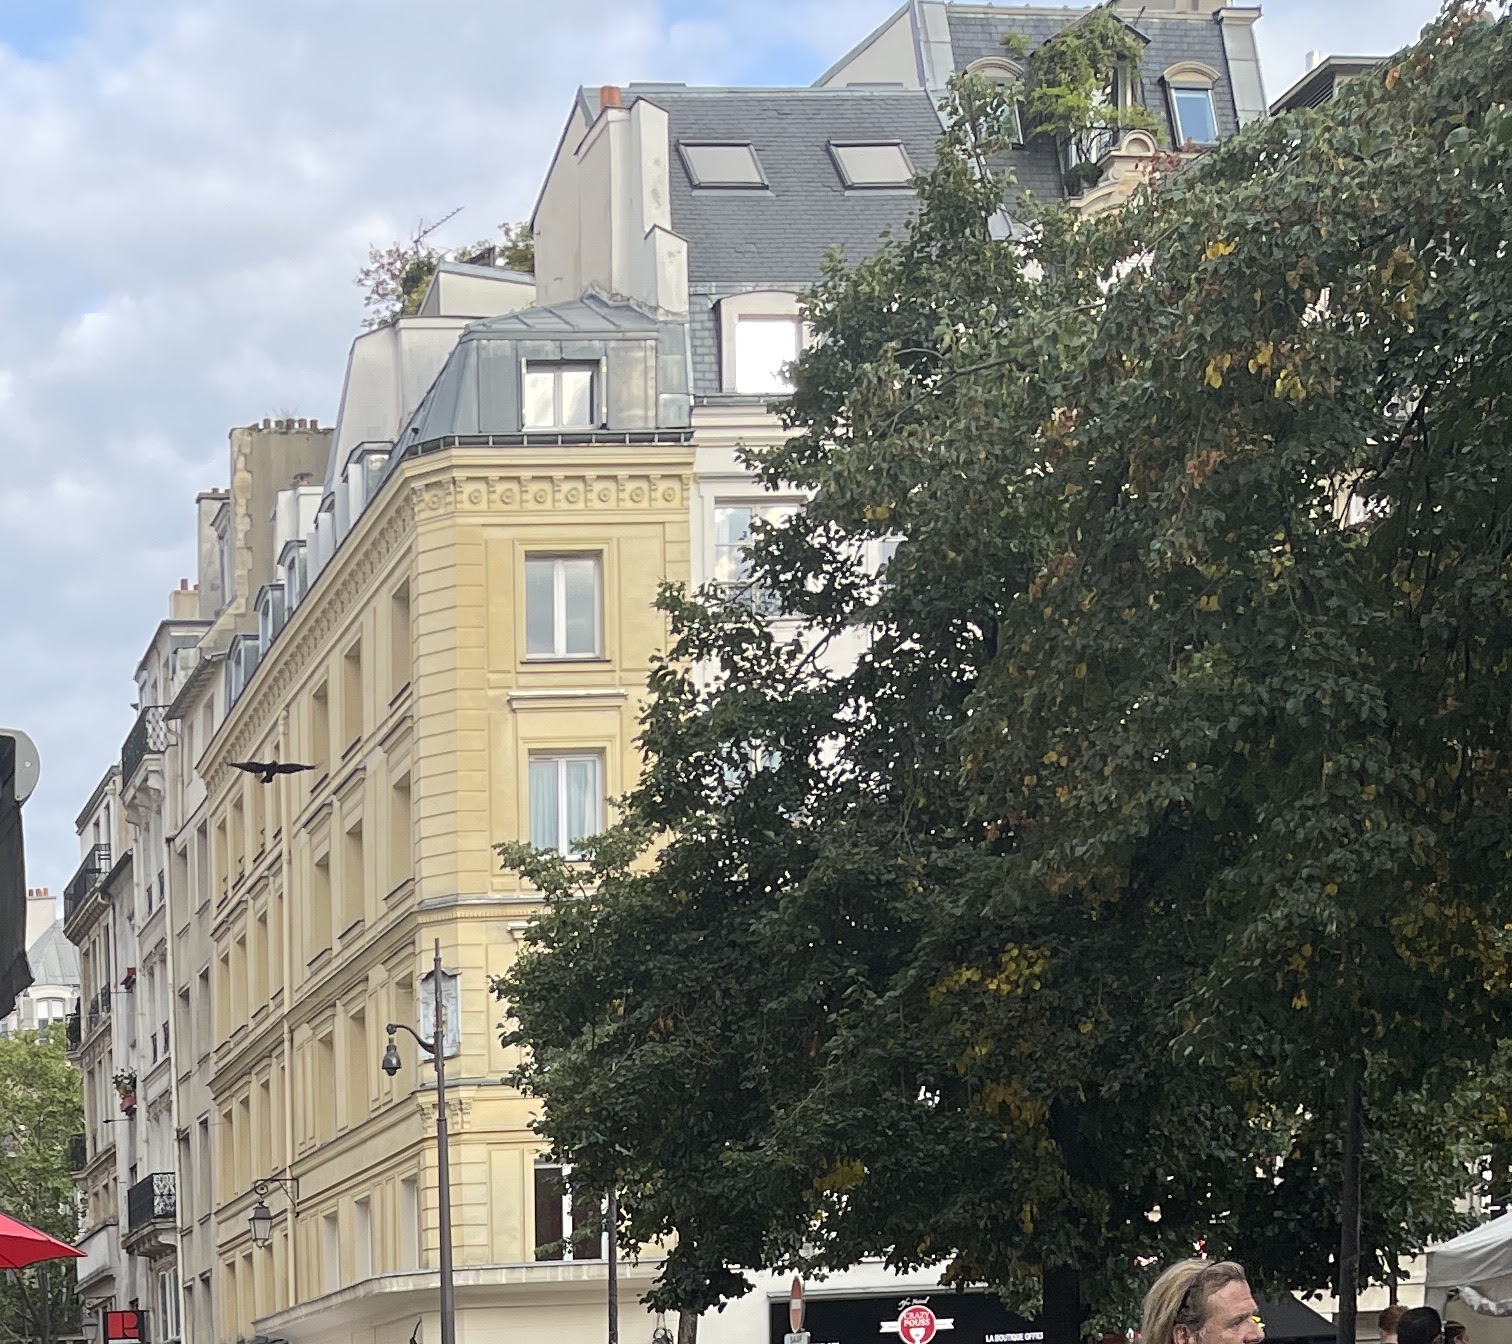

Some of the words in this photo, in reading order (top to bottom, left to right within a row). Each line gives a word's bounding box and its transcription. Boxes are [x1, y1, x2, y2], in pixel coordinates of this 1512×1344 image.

[903, 1311, 930, 1319] CRAZY
[903, 1318, 931, 1328] POUSS
[985, 1334, 994, 1343] LA
[994, 1332, 1024, 1343] BOUTIQUE
